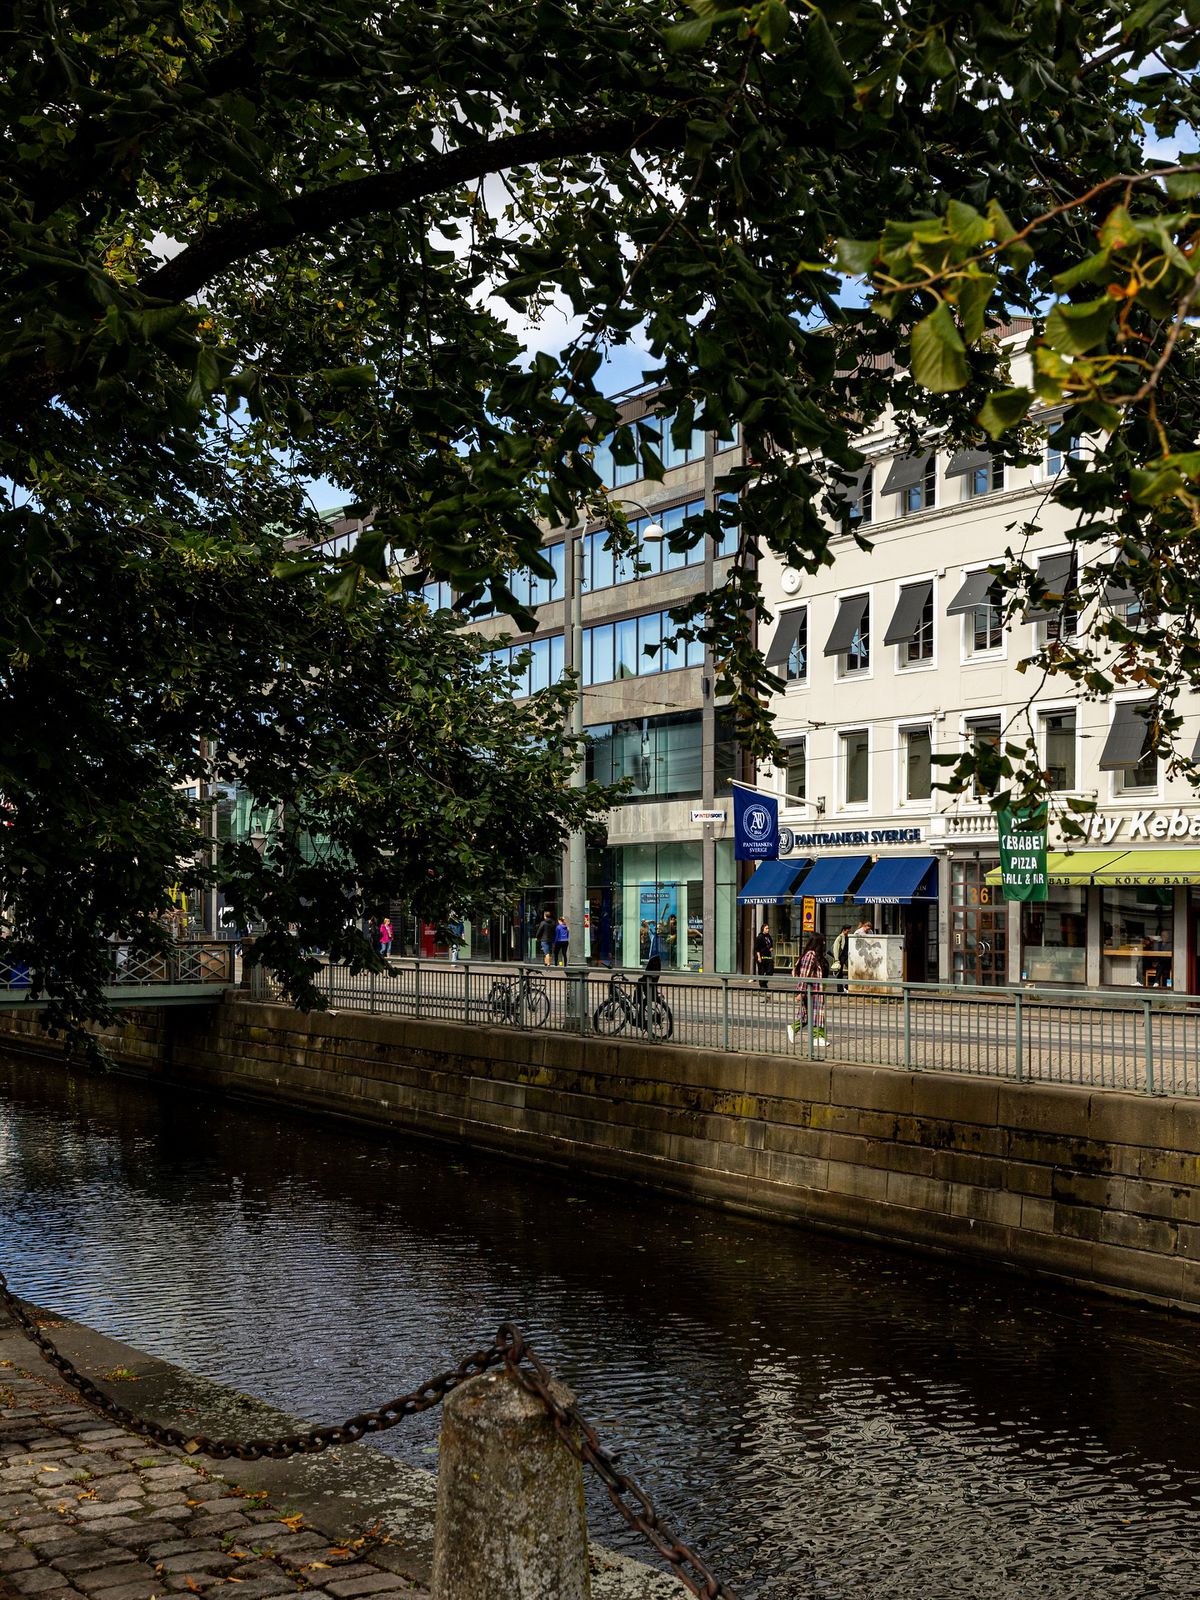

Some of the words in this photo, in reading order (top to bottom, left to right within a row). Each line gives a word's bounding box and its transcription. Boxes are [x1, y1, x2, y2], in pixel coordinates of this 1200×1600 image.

[1128, 809, 1200, 838] Keba
[795, 831, 869, 846] PANTBANKEN
[871, 828, 921, 842] SVERIGE
[1010, 857, 1038, 869] PIZZA
[1025, 873, 1031, 885] &
[1048, 877, 1070, 885] BAB
[1115, 876, 1141, 885] KÖK
[1147, 877, 1157, 885] &
[1163, 877, 1191, 885] BAR
[970, 887, 989, 904] 36
